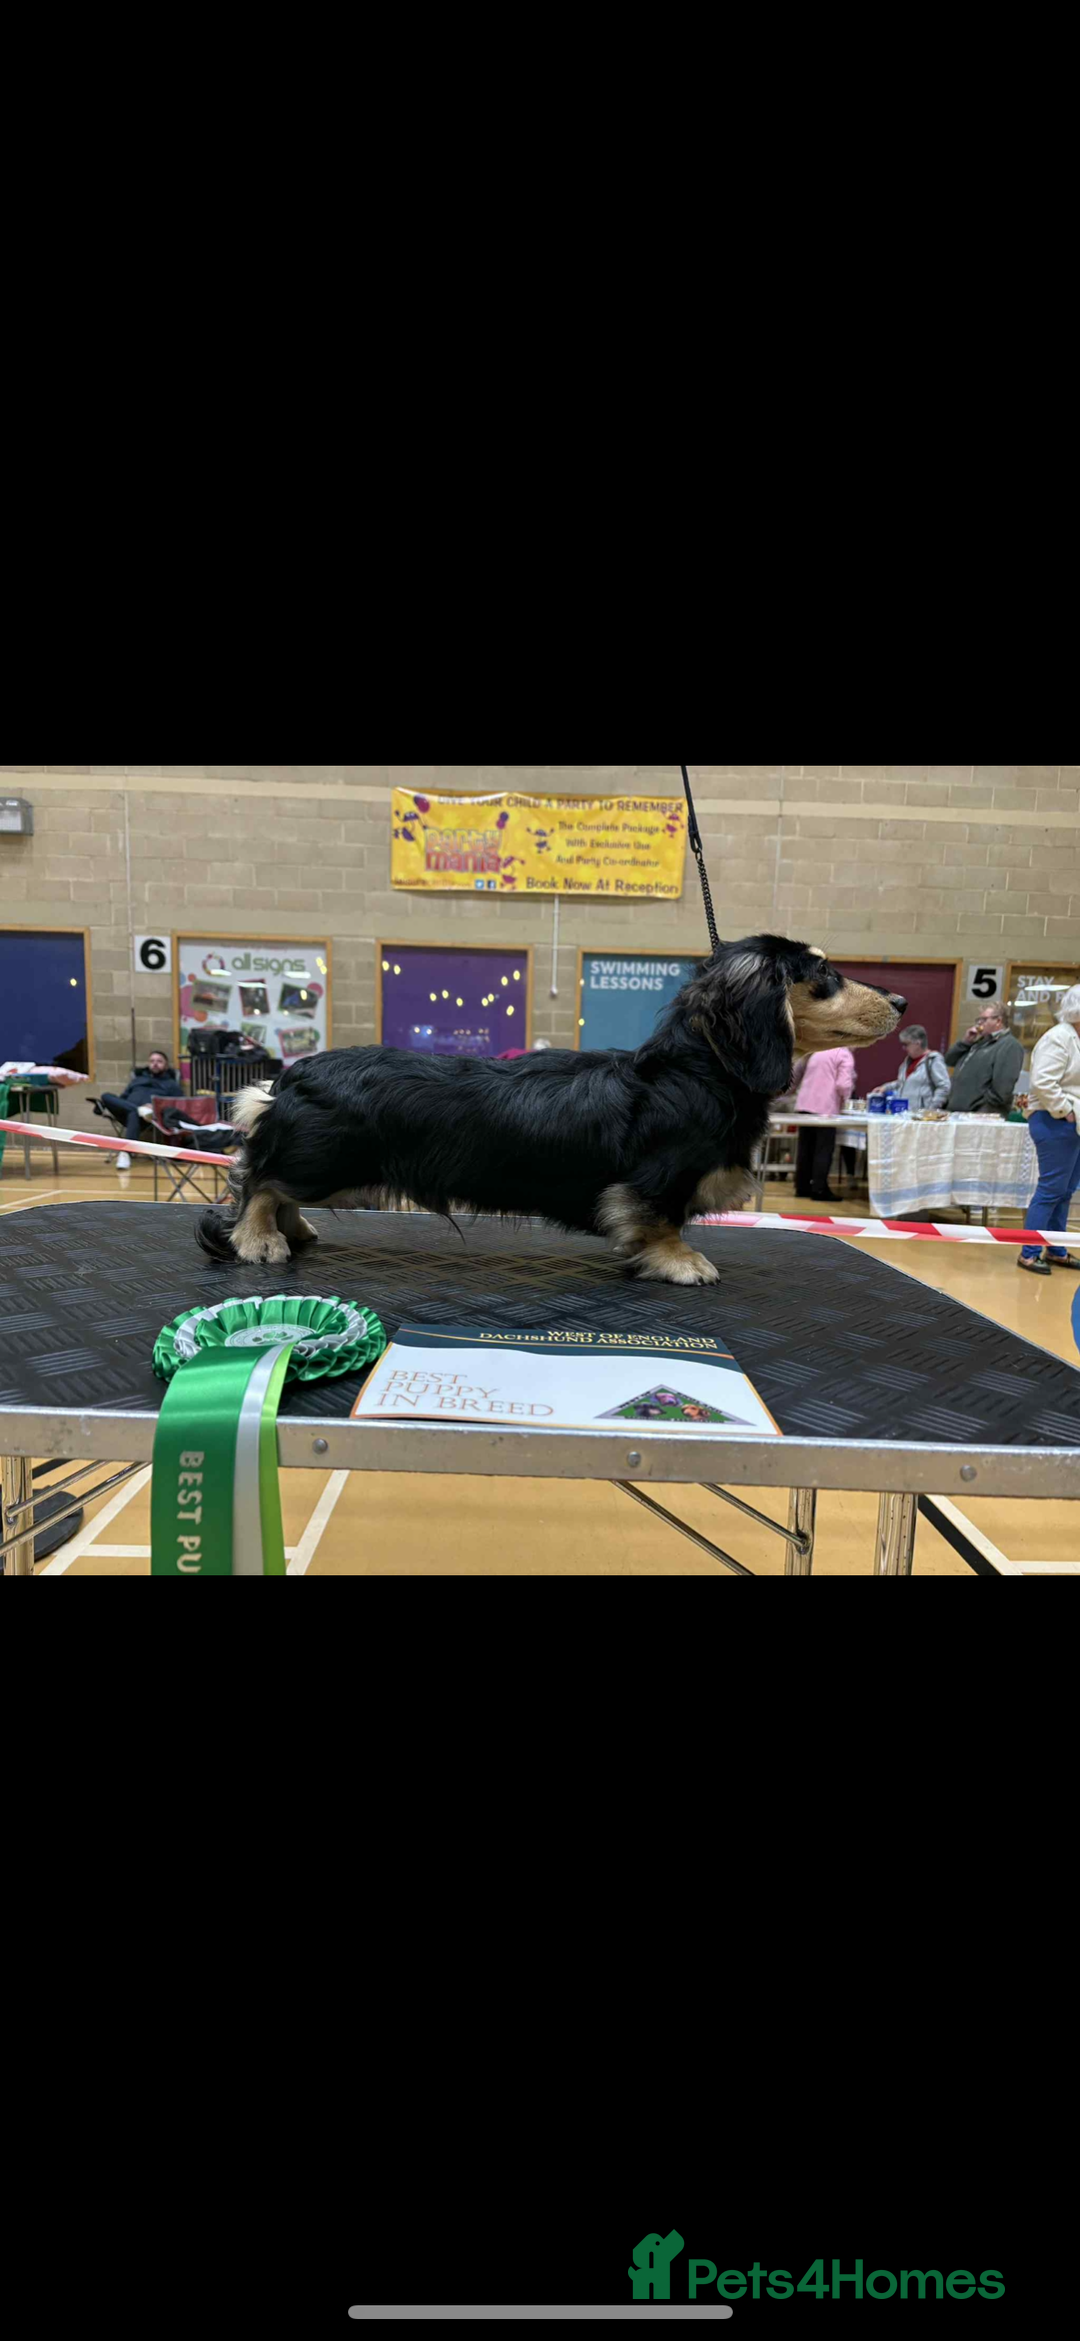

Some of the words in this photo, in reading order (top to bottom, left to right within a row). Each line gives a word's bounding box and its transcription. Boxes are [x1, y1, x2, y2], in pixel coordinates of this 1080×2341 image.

[507, 796, 541, 808] CHILD
[557, 799, 593, 810] PARTY
[599, 800, 613, 811] TO
[617, 800, 683, 813] REMEMBER
[558, 821, 573, 831] The
[577, 822, 619, 833] Complete
[622, 823, 660, 835] Package
[566, 838, 586, 848] With
[590, 839, 631, 849] Exclusive
[633, 840, 650, 850] Use
[556, 855, 574, 865] And
[576, 856, 600, 867] Party
[603, 857, 660, 868] Co-ordinator
[526, 876, 558, 889] Book
[563, 877, 592, 890] Now
[596, 879, 610, 890] At
[615, 879, 679, 894] Reception
[140, 938, 166, 970] 6
[590, 961, 680, 976] SWIMMING
[590, 976, 664, 990] LESSONS
[972, 969, 997, 999] 5
[1017, 975, 1054, 988] STAY
[1016, 990, 1051, 1003] AND
[479, 1332, 594, 1344] DACHSHUND
[597, 1337, 718, 1349] ASSOCIATION
[600, 1332, 625, 1340] OF
[627, 1333, 716, 1344] ENGLAND
[390, 1370, 467, 1384] BEST
[383, 1381, 499, 1399] PUPPY
[376, 1393, 421, 1407] IN
[437, 1397, 554, 1417] BREED
[177, 1450, 204, 1525] BEST
